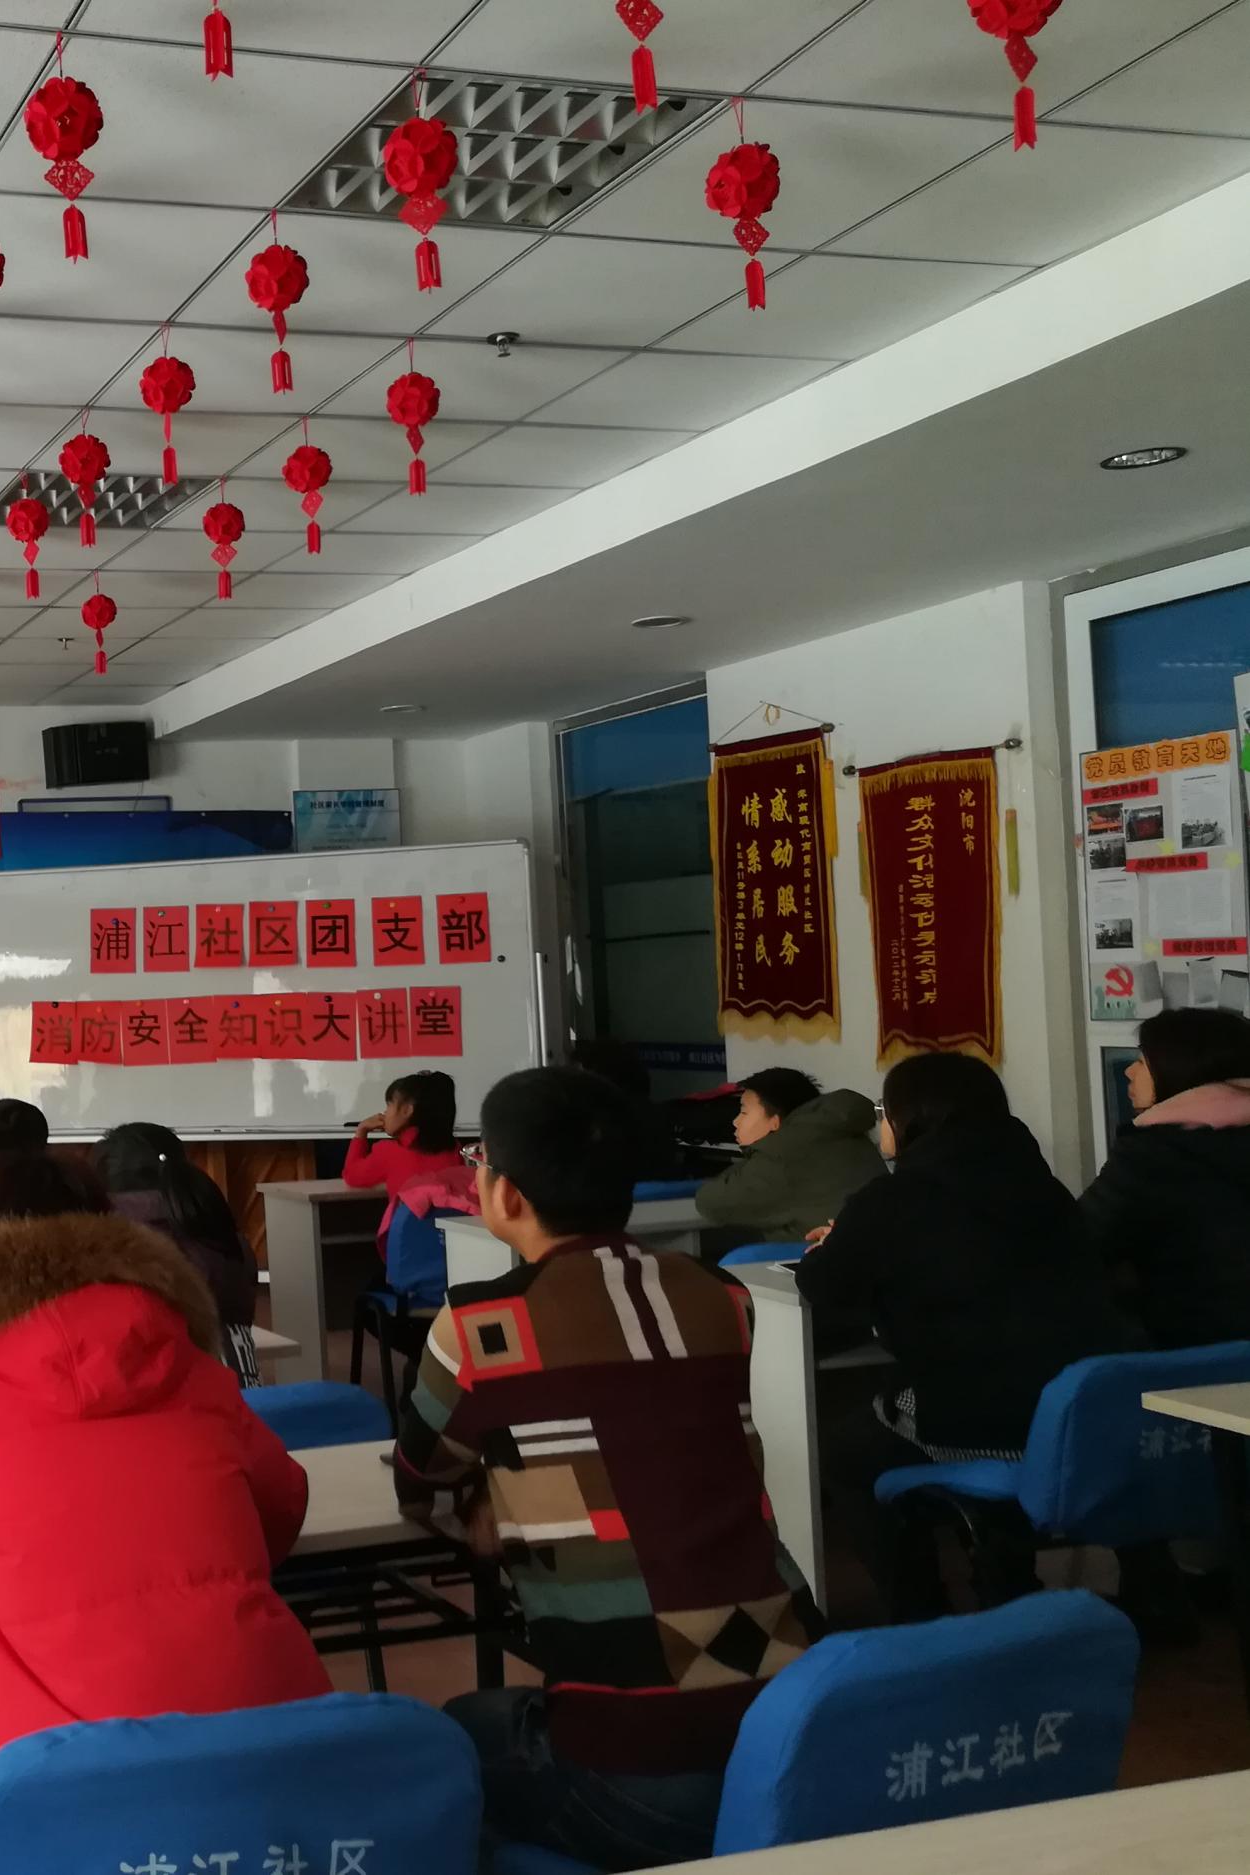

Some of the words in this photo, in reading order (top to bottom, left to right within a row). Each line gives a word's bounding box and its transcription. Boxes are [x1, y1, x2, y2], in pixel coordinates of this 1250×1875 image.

[1086, 737, 1227, 779] 党员教育天地
[958, 787, 976, 856] 沈阳市
[740, 791, 772, 968] 情系居民
[769, 788, 801, 966] 感动服务
[92, 909, 487, 961] 浦江社区团支部
[34, 998, 456, 1056] 消防安全知识大讲堂
[886, 1712, 1073, 1801] 浦江社区
